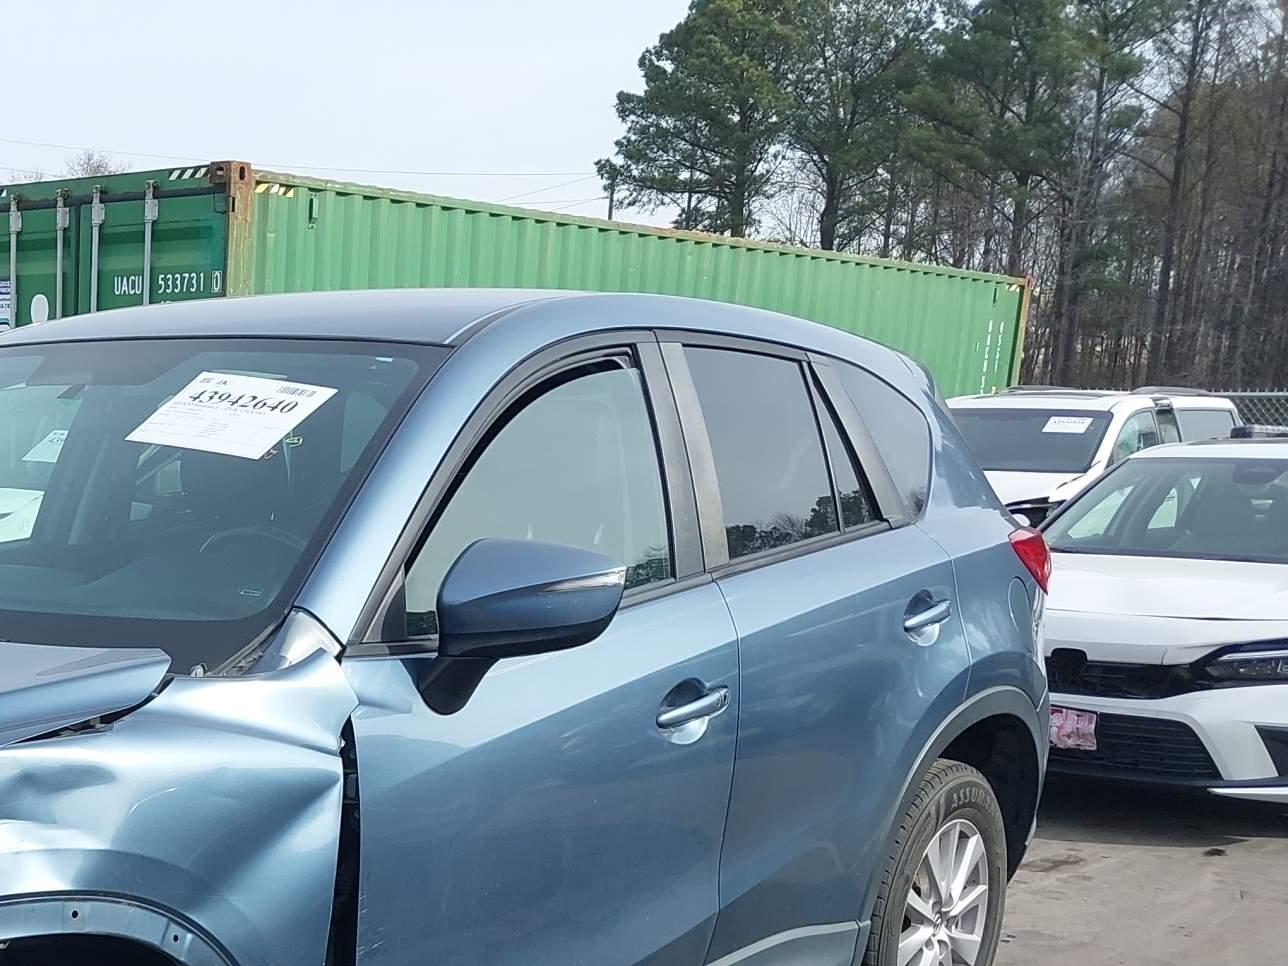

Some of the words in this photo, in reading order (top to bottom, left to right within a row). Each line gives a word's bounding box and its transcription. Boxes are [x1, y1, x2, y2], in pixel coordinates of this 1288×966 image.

[114, 275, 143, 295] UACU
[157, 272, 204, 294] 533731
[212, 271, 222, 292] 0
[188, 389, 298, 414] 43942640
